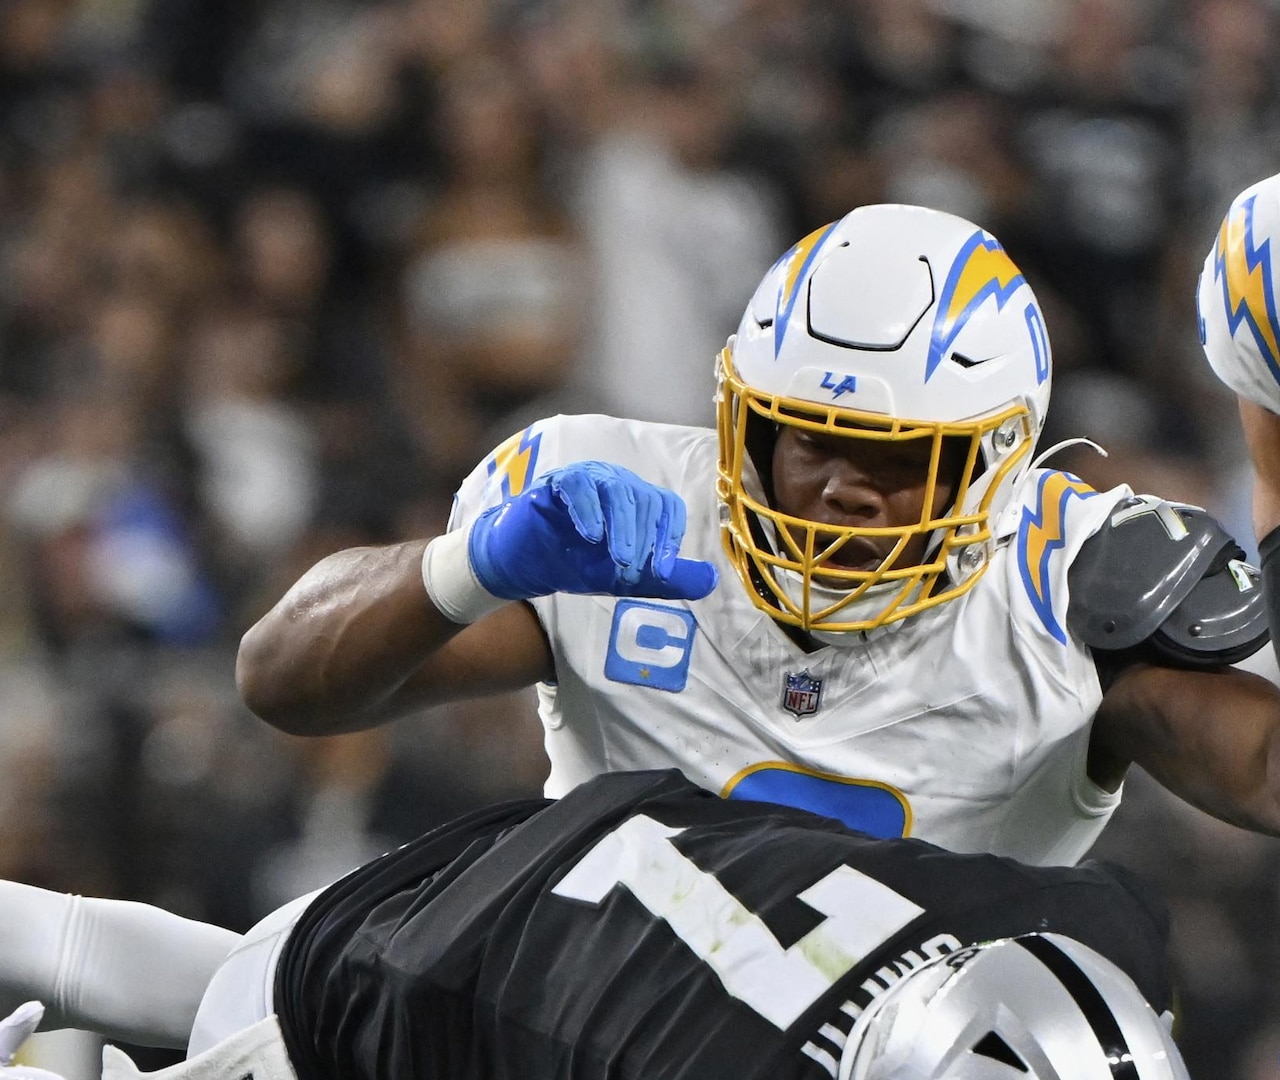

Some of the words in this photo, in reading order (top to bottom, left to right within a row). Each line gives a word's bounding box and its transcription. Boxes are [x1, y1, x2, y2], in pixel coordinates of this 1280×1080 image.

[820, 371, 857, 400] LA
[615, 607, 688, 668] C
[787, 690, 815, 711] NFL
